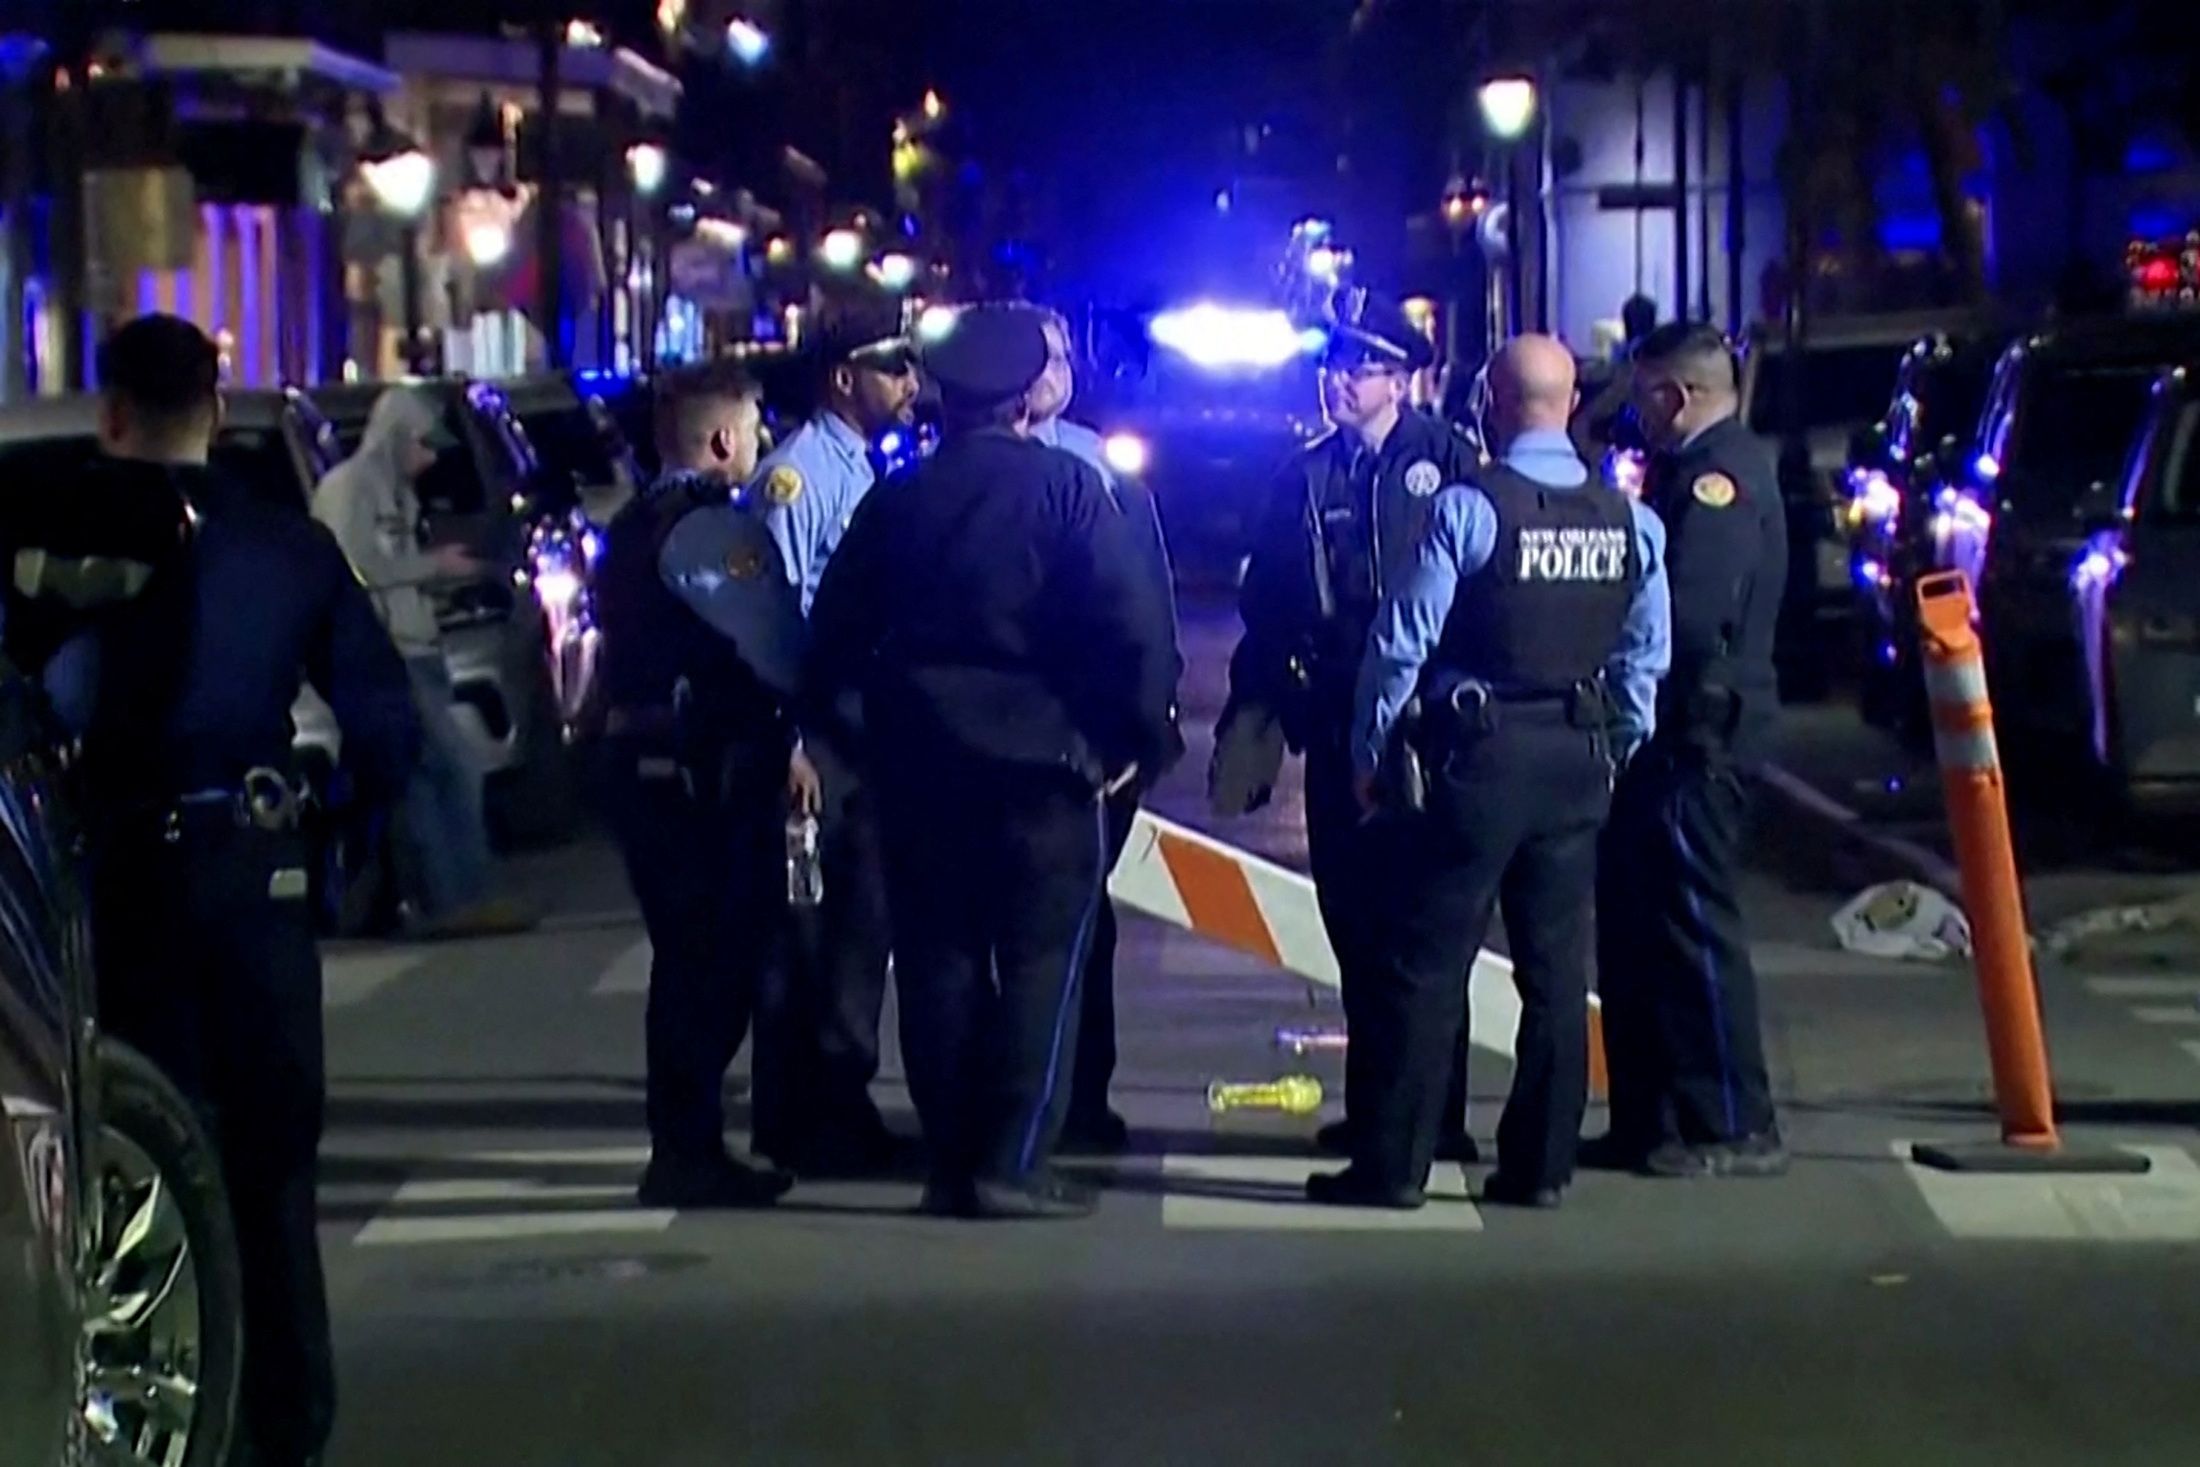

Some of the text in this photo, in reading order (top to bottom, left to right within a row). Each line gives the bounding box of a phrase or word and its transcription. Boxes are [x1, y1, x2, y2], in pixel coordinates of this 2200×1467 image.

[1519, 527, 1627, 546] NEW ORLEANS
[1519, 545, 1627, 580] POLICE
